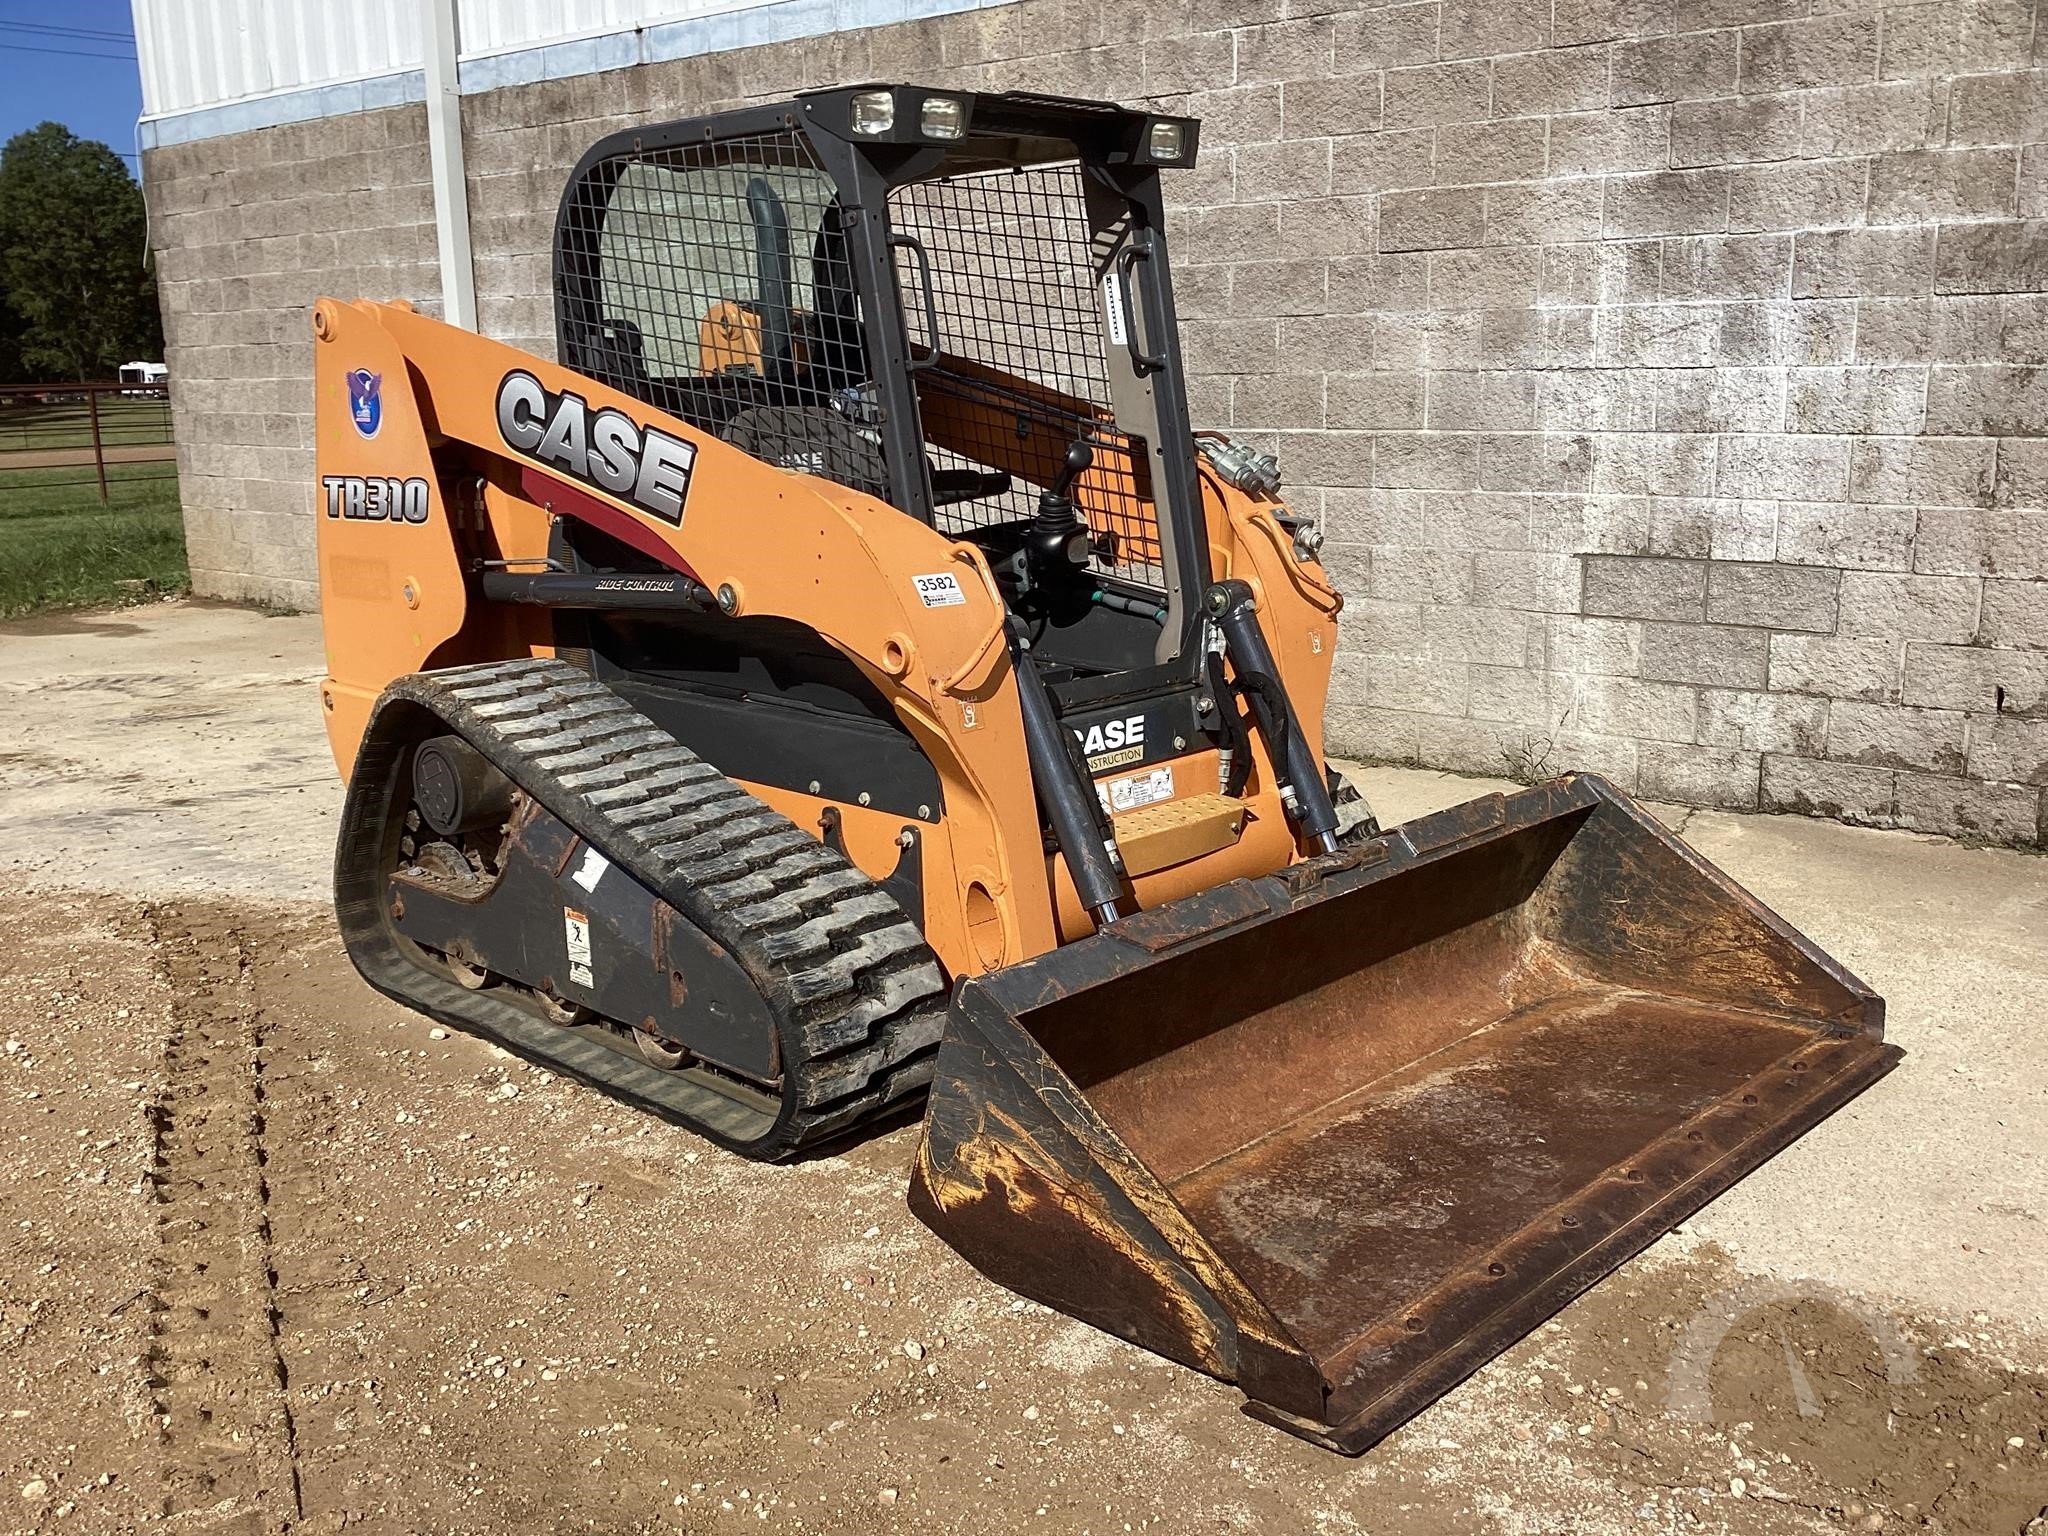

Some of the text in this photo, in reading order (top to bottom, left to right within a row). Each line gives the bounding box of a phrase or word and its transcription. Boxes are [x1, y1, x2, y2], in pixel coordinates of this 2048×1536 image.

[498, 371, 695, 520] CASE
[323, 476, 429, 523] TR310
[595, 579, 675, 592] RIDE CONTROL
[917, 576, 956, 592] 3582
